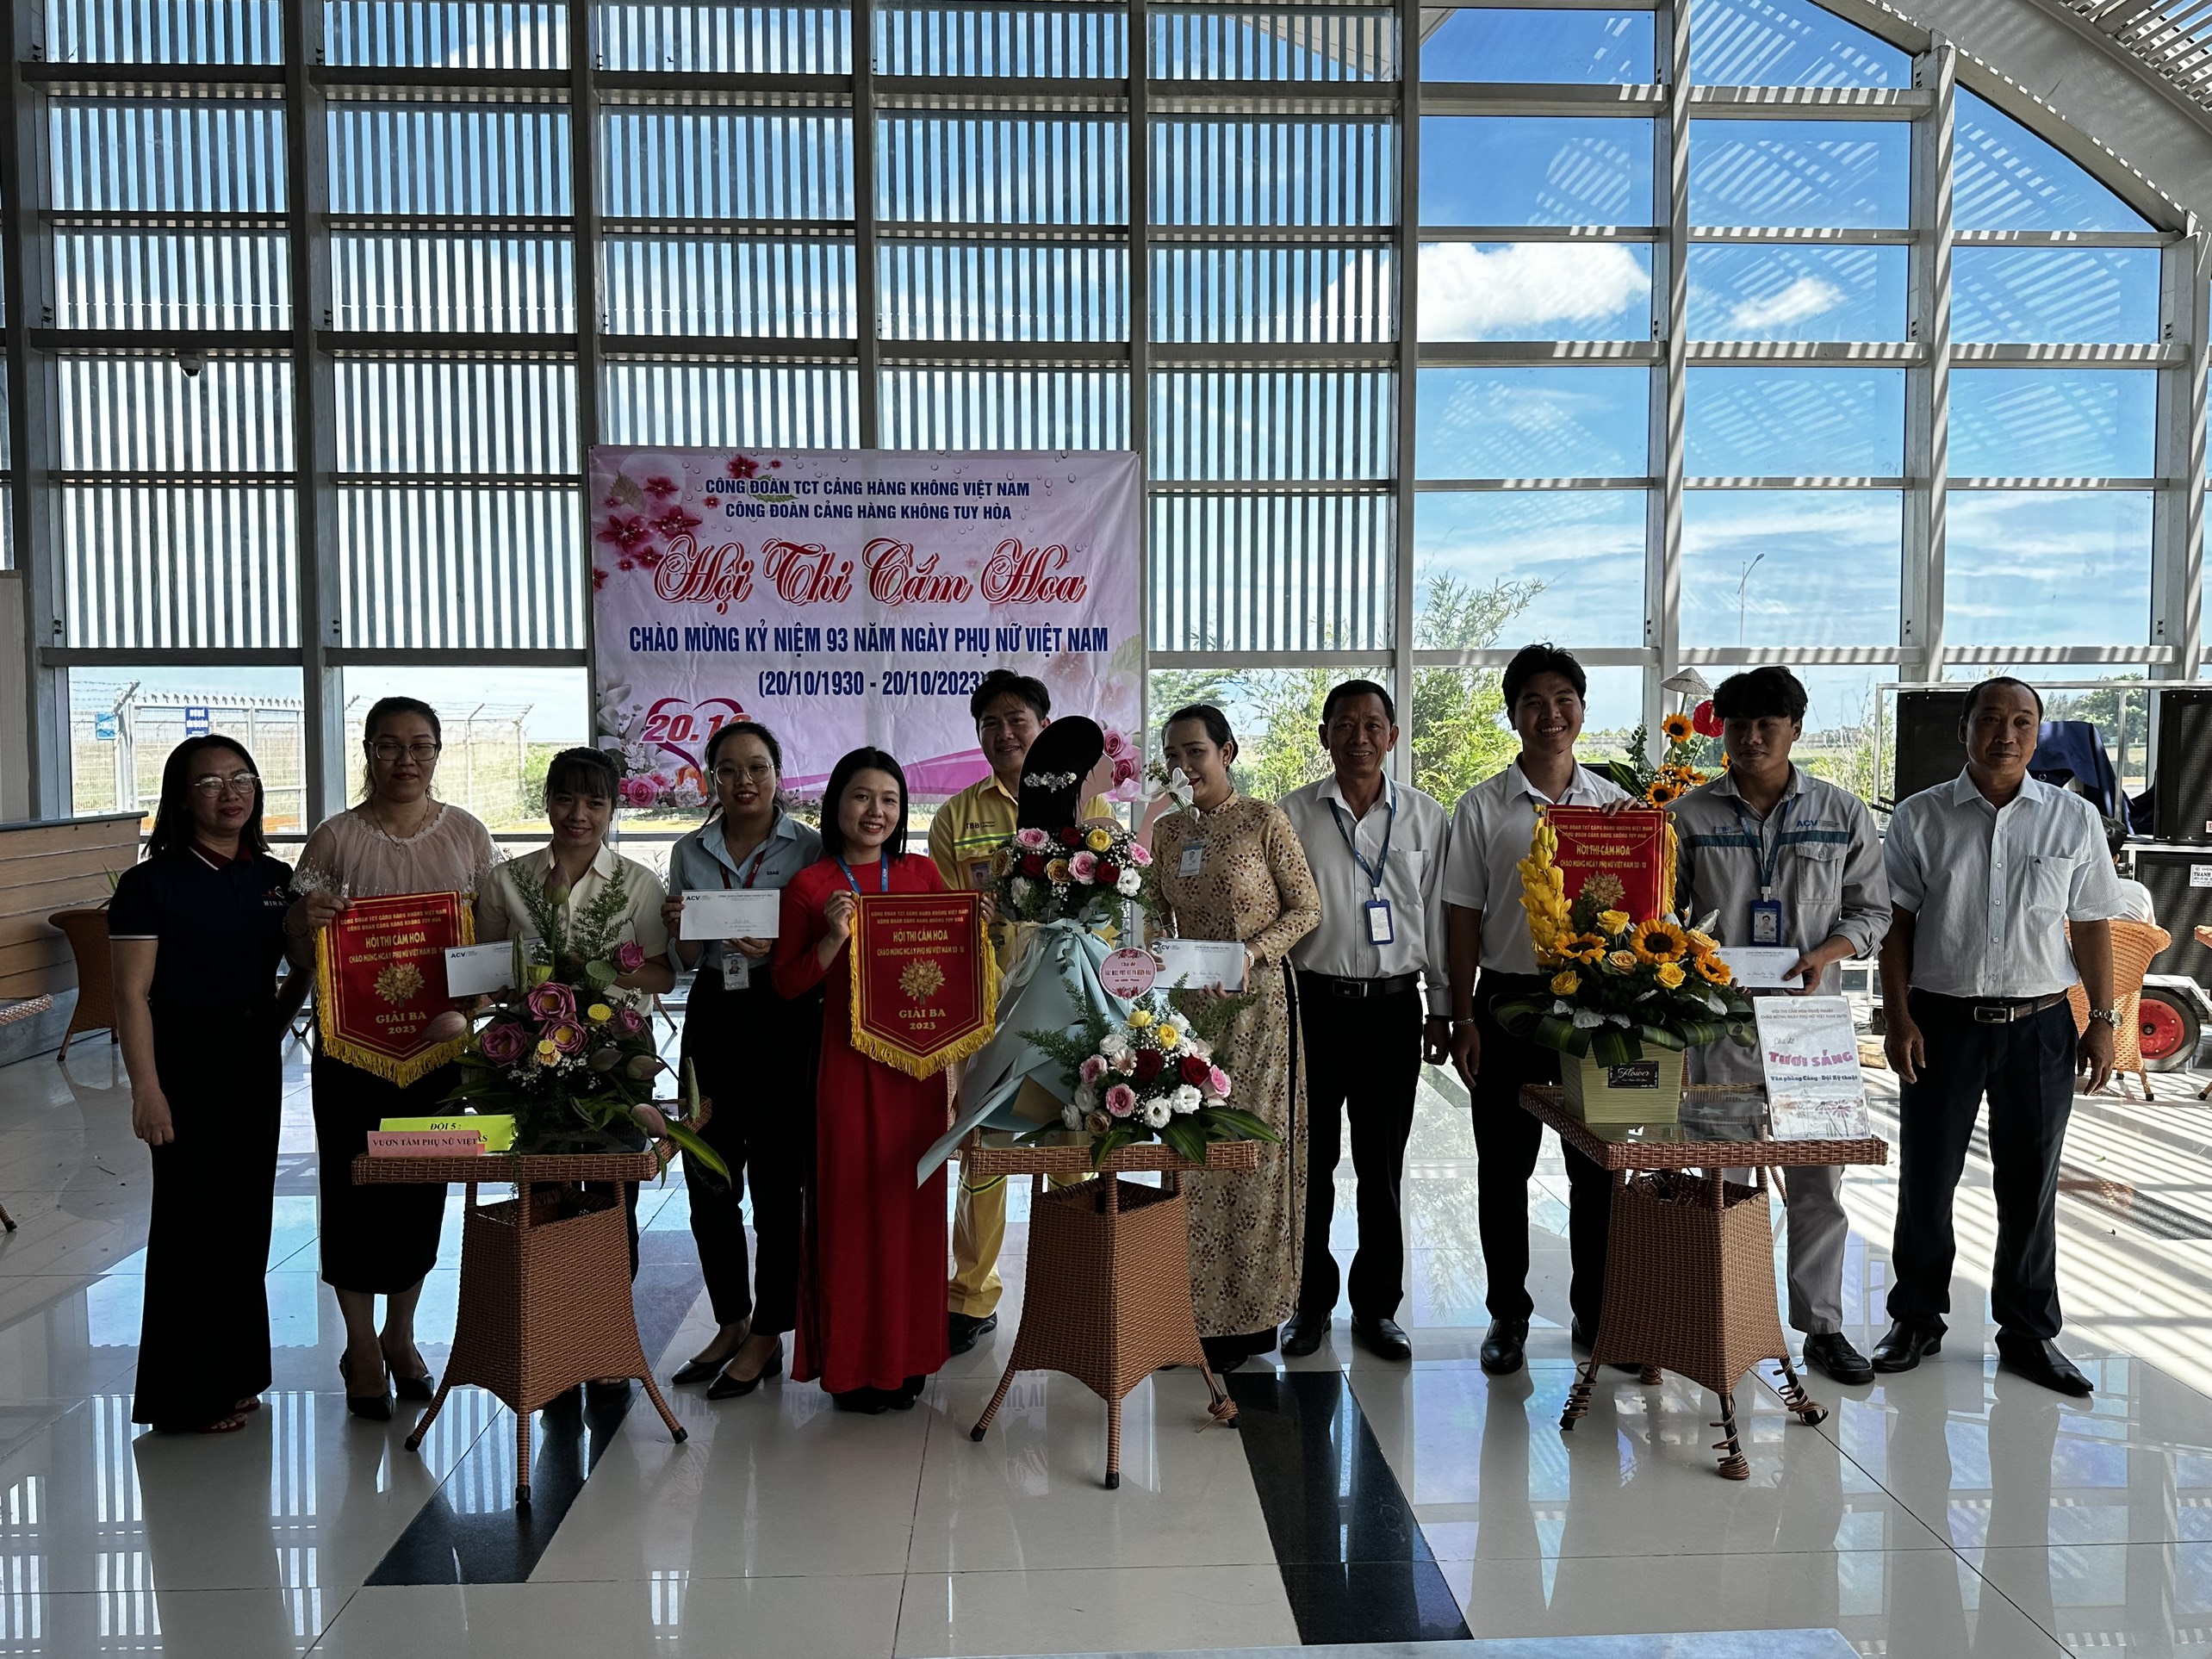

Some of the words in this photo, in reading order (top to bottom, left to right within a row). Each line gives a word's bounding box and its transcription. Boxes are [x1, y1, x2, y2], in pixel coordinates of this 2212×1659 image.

[705, 477, 745, 494] CÔNG
[749, 476, 790, 494] ĐOÀN
[793, 481, 819, 494] TCT
[823, 477, 863, 495] CẢNG
[867, 479, 906, 495] HÀNG
[910, 480, 959, 496] KHÔNG
[963, 480, 992, 499] VIỆT
[997, 482, 1029, 496] NAM
[725, 501, 765, 518] CÔNG
[769, 501, 809, 518] ĐOÀN
[814, 500, 853, 519] CẢNG
[857, 502, 897, 519] HÀNG
[901, 503, 949, 519] KHÔNG
[953, 506, 979, 519] TUY
[984, 503, 1012, 519] HÒA
[654, 532, 755, 615] Hội
[761, 537, 854, 606] Thi
[861, 537, 973, 606] Cắm
[980, 537, 1087, 605] Hoa
[630, 622, 679, 652] CHÀO
[685, 622, 740, 652] MỪNG
[745, 618, 768, 652] KỶ
[774, 622, 821, 657] NIỆM
[826, 627, 848, 652] 93
[854, 623, 895, 652] NĂM
[901, 623, 948, 652] NGÀY
[954, 627, 990, 657] PHỤ
[996, 623, 1022, 652] NỮ
[1025, 623, 1062, 657] VIỆT
[1067, 627, 1108, 652] NAM
[758, 670, 864, 698] (20/10/1930
[642, 714, 751, 743] 20.1
[1796, 819, 1818, 828] ACV
[1576, 842, 1589, 857] HỘI
[1590, 845, 1599, 855] THI
[1601, 841, 1615, 855] CẮM
[1616, 845, 1631, 855] HOA
[365, 934, 379, 949] HỘI
[380, 935, 391, 947] THI
[393, 929, 408, 945] CẮM
[409, 931, 426, 944] HOA
[893, 929, 905, 944] HỘI
[906, 931, 916, 941] THI
[917, 925, 932, 941] CẮM
[933, 929, 948, 941] HOA
[376, 1011, 405, 1024] GIẢI
[408, 1011, 427, 1021] BA
[898, 1007, 926, 1018] GIẢI
[929, 1009, 946, 1017] BA
[388, 1025, 417, 1035] 2023
[1769, 1051, 1807, 1066] TƯƠI
[1811, 1049, 1854, 1066] SÁNG
[1617, 1067, 1650, 1078] Flower
[431, 1122, 448, 1131] ĐỘI
